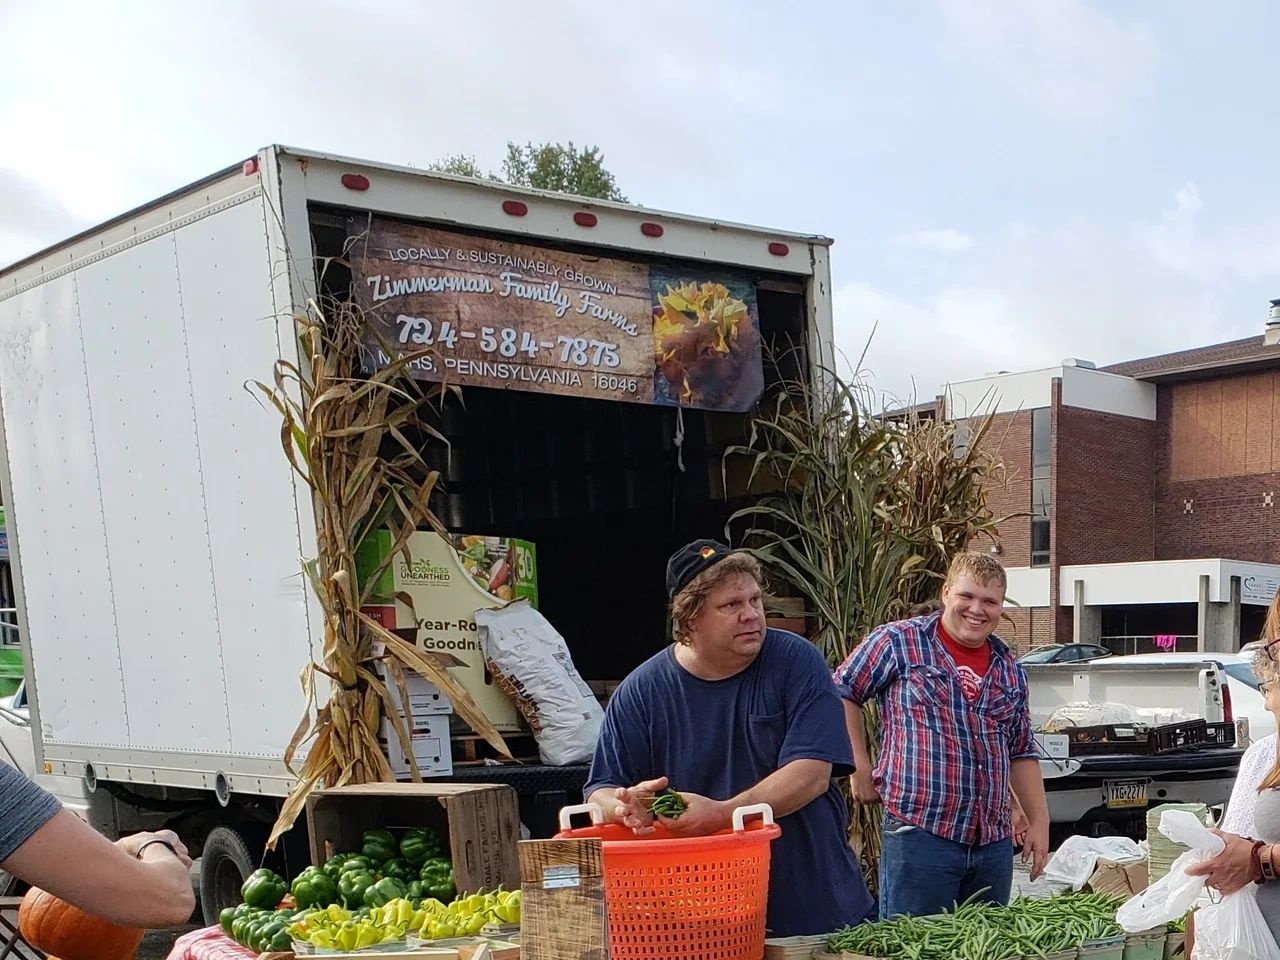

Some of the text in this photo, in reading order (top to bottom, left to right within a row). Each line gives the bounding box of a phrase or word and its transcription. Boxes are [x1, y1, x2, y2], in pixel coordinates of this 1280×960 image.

[389, 247, 618, 296] LOCALLY & SUSTAINABLY GROWN
[366, 271, 638, 336] Zimmerman Family Farms
[396, 314, 621, 369] 724-584-7875
[444, 357, 582, 388] PENNSYLVANIA
[591, 374, 637, 393] 16046
[400, 565, 450, 574] GODNESS
[400, 572, 451, 581] UNEARTHED
